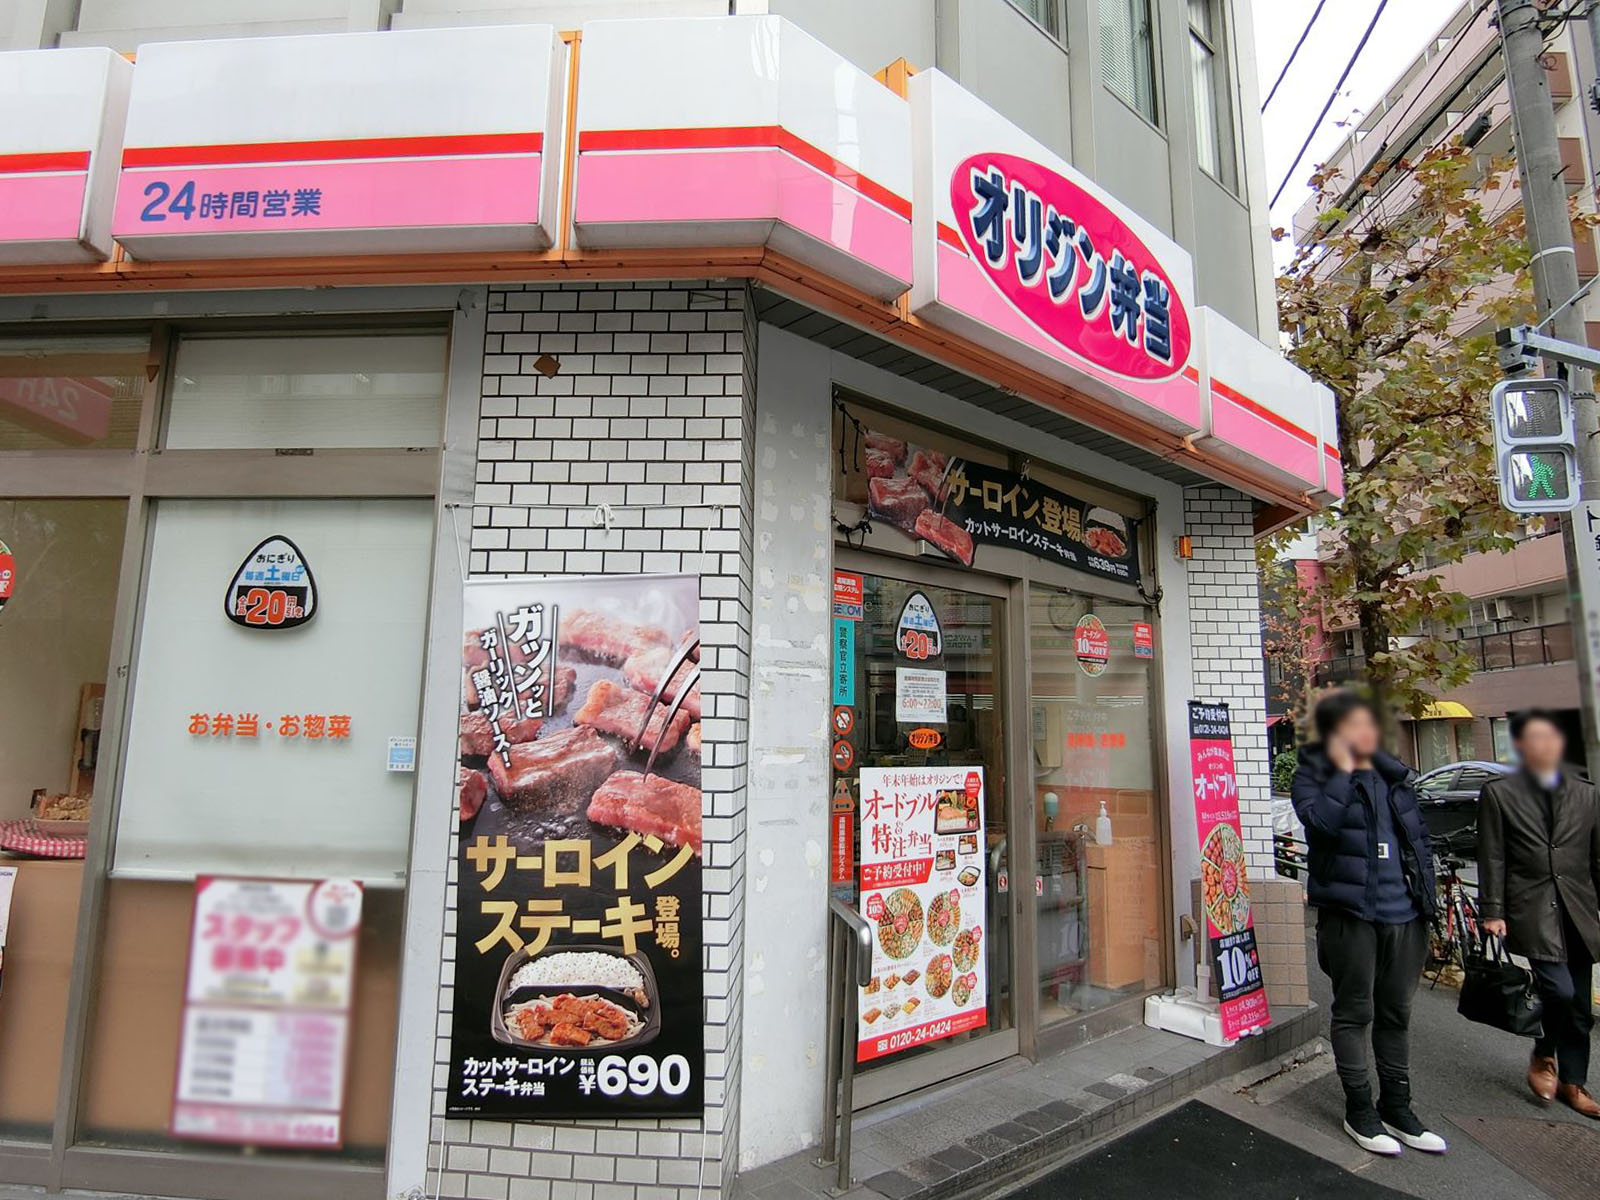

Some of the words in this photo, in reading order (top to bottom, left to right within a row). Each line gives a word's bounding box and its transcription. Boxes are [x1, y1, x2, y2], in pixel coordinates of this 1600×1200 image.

[140, 180, 322, 222] 24時間営業
[969, 166, 1173, 366] オリジン弁当
[256, 553, 295, 564] おにぎり
[480, 628, 513, 709] ガーリック
[188, 712, 352, 739] お弁当・お惣菜
[862, 789, 940, 822] オードブル
[871, 823, 932, 859] 特注弁当
[467, 830, 694, 892] サーロイン
[474, 895, 653, 957] ステーキ
[655, 895, 681, 959] 登場。
[889, 1019, 951, 1049] 0120-24-0424
[463, 1056, 576, 1076] カットサーロイン
[462, 1077, 545, 1096] ステーキ弁当
